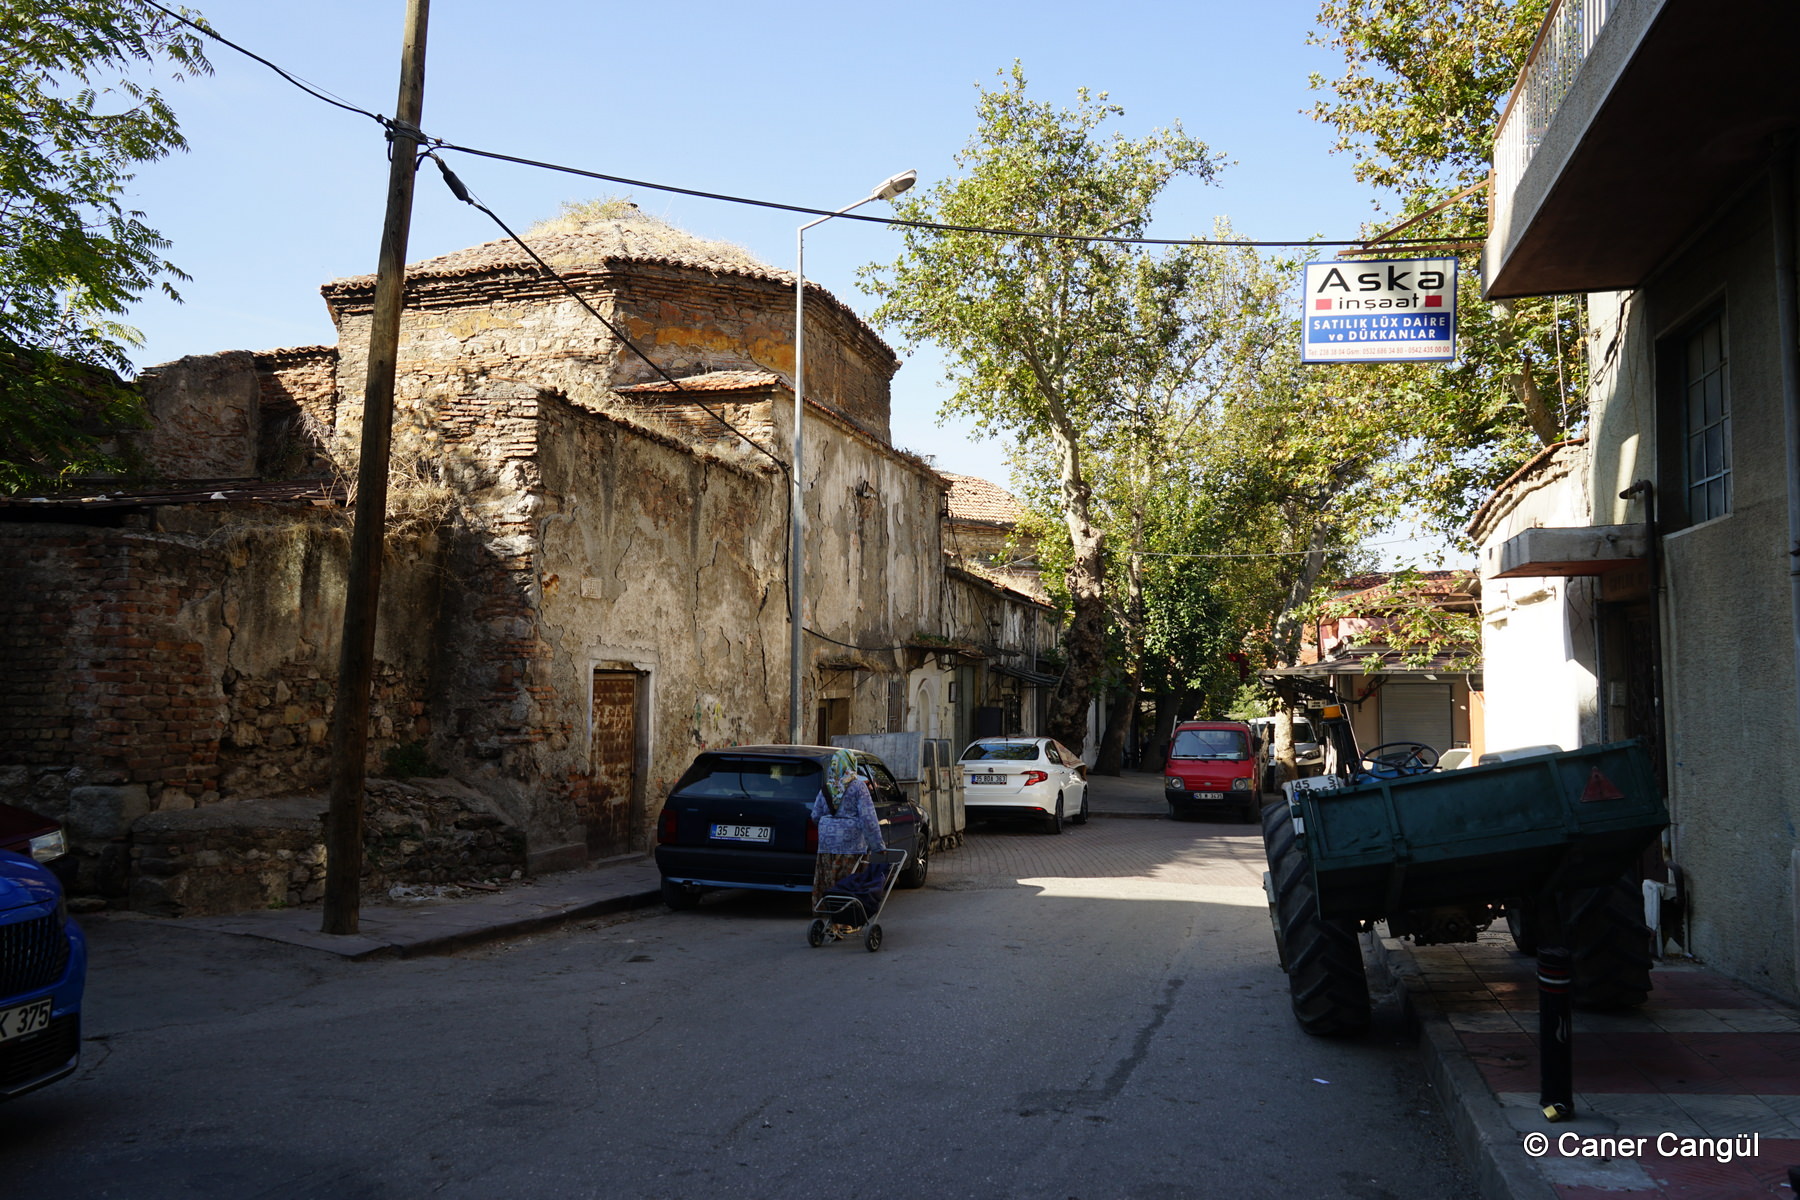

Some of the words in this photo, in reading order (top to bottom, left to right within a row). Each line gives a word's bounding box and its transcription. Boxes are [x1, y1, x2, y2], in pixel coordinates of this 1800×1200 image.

[1317, 265, 1445, 293] Aska
[1339, 292, 1420, 311] inşaat
[1313, 316, 1368, 330] SATILIK
[1372, 315, 1398, 328] LÜX
[1403, 314, 1446, 328] DAİRE
[1328, 333, 1344, 342] ve
[1348, 328, 1436, 341] DÜKKANLAR
[1295, 780, 1310, 789] 45
[1327, 775, 1336, 785] S
[717, 825, 728, 836] 35
[734, 826, 751, 837] DSE
[757, 827, 769, 838] 20
[16, 1001, 50, 1034] 375
